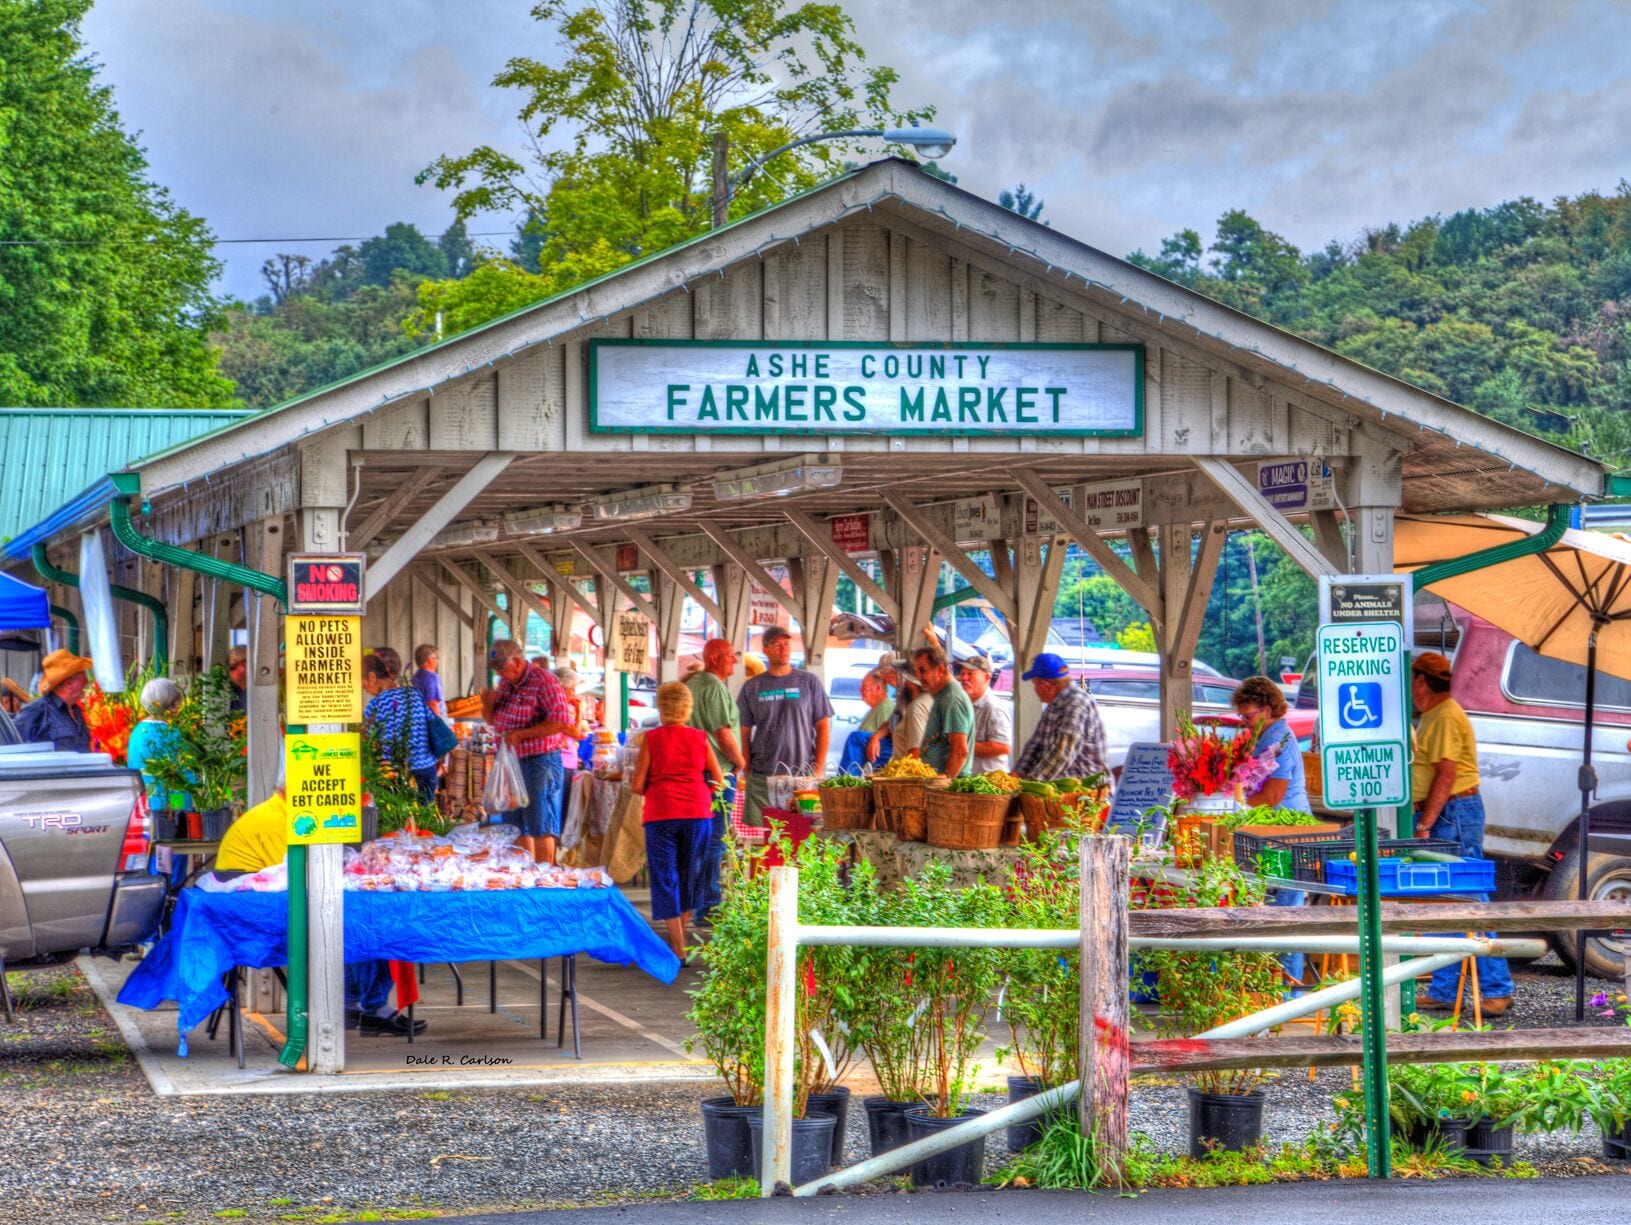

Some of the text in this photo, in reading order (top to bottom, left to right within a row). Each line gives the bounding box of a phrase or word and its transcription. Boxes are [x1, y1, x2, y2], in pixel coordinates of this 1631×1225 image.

[745, 353, 991, 379] ASHE COUNTY
[667, 384, 1067, 423] FARMERS MARKET
[1271, 465, 1296, 485] MAGIC
[1097, 491, 1114, 508] STREET
[1115, 488, 1140, 507] DISCOUNT
[309, 564, 344, 583] NO
[297, 582, 358, 602] SMOKING
[1341, 601, 1353, 609] NO
[1363, 609, 1400, 617] SHELTER
[299, 619, 349, 632] NO PETS
[296, 633, 352, 646] ALLOWED
[1323, 636, 1397, 655] RESERVED
[304, 646, 345, 658] INSIDE
[295, 659, 352, 672] FARMERS
[1328, 658, 1391, 677] PARKING
[298, 672, 352, 684] MARKET!
[1334, 747, 1394, 765] MAXIMUM
[313, 764, 331, 776] WE
[1337, 764, 1391, 781] PENALTY
[301, 778, 346, 792] ACCEPT
[292, 793, 356, 807] EBT CARDS
[21, 813, 82, 831] TRD
[65, 824, 111, 835] SPORT
